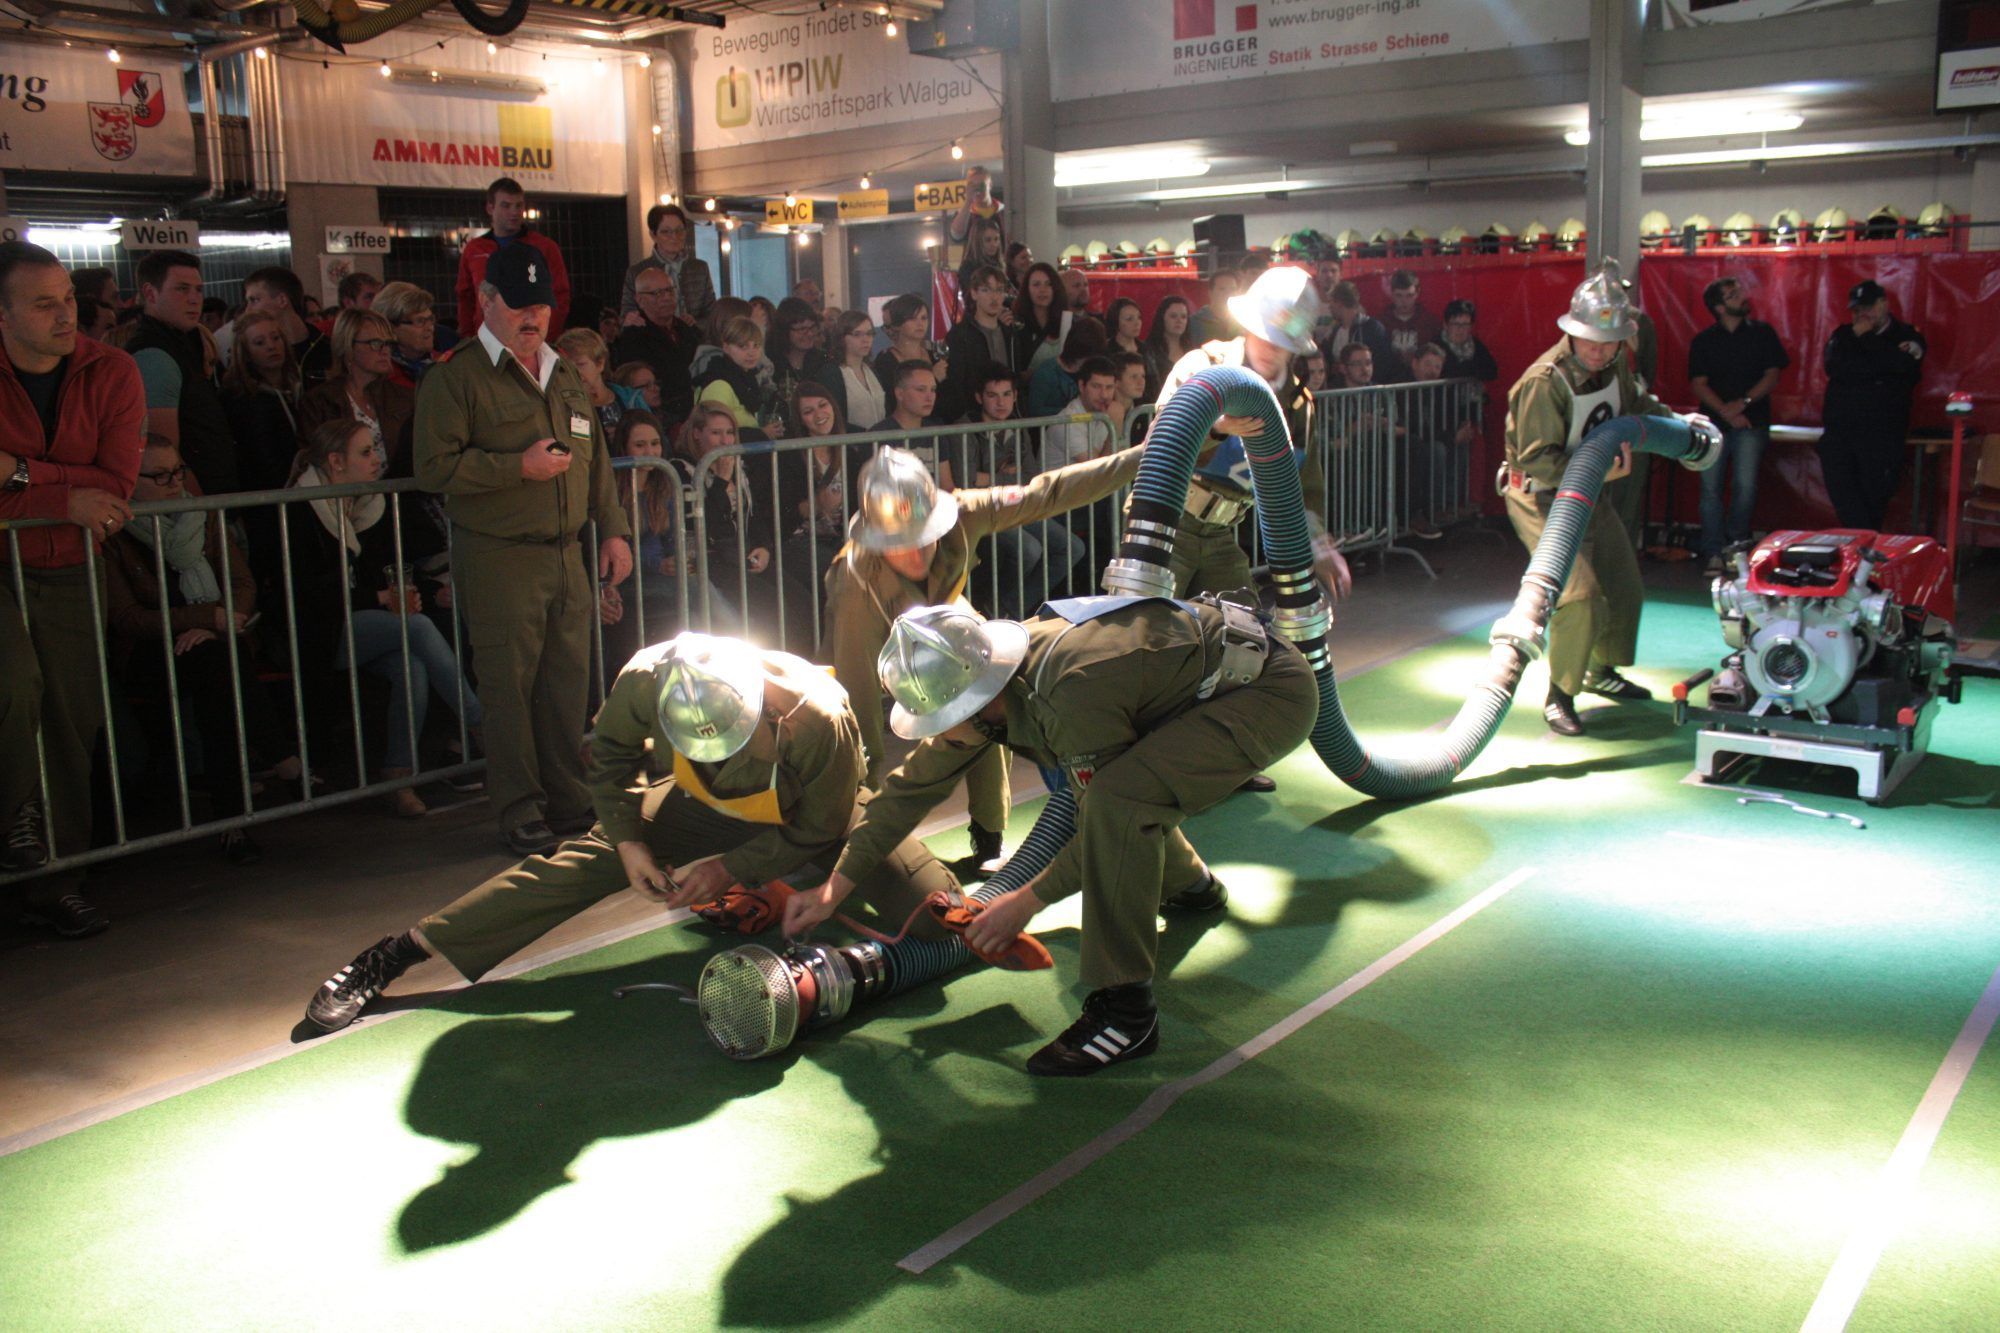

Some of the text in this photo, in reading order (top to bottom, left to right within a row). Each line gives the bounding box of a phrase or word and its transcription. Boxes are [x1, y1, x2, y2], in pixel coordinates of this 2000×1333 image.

[1268, 0, 1421, 28] www.brugger-ing.at
[713, 25, 800, 57] Bewegung
[806, 8, 857, 39] findet
[1173, 36, 1259, 60] BRUGGER
[1268, 31, 1450, 66] Statik Strasse Schiene
[1173, 53, 1259, 76] INGENIEURE
[756, 77, 973, 127] Wirtschaftspark Walgau
[928, 184, 967, 207] BAR
[782, 202, 808, 221] WC
[133, 225, 189, 245] Wein
[329, 231, 387, 249] Kaffee
